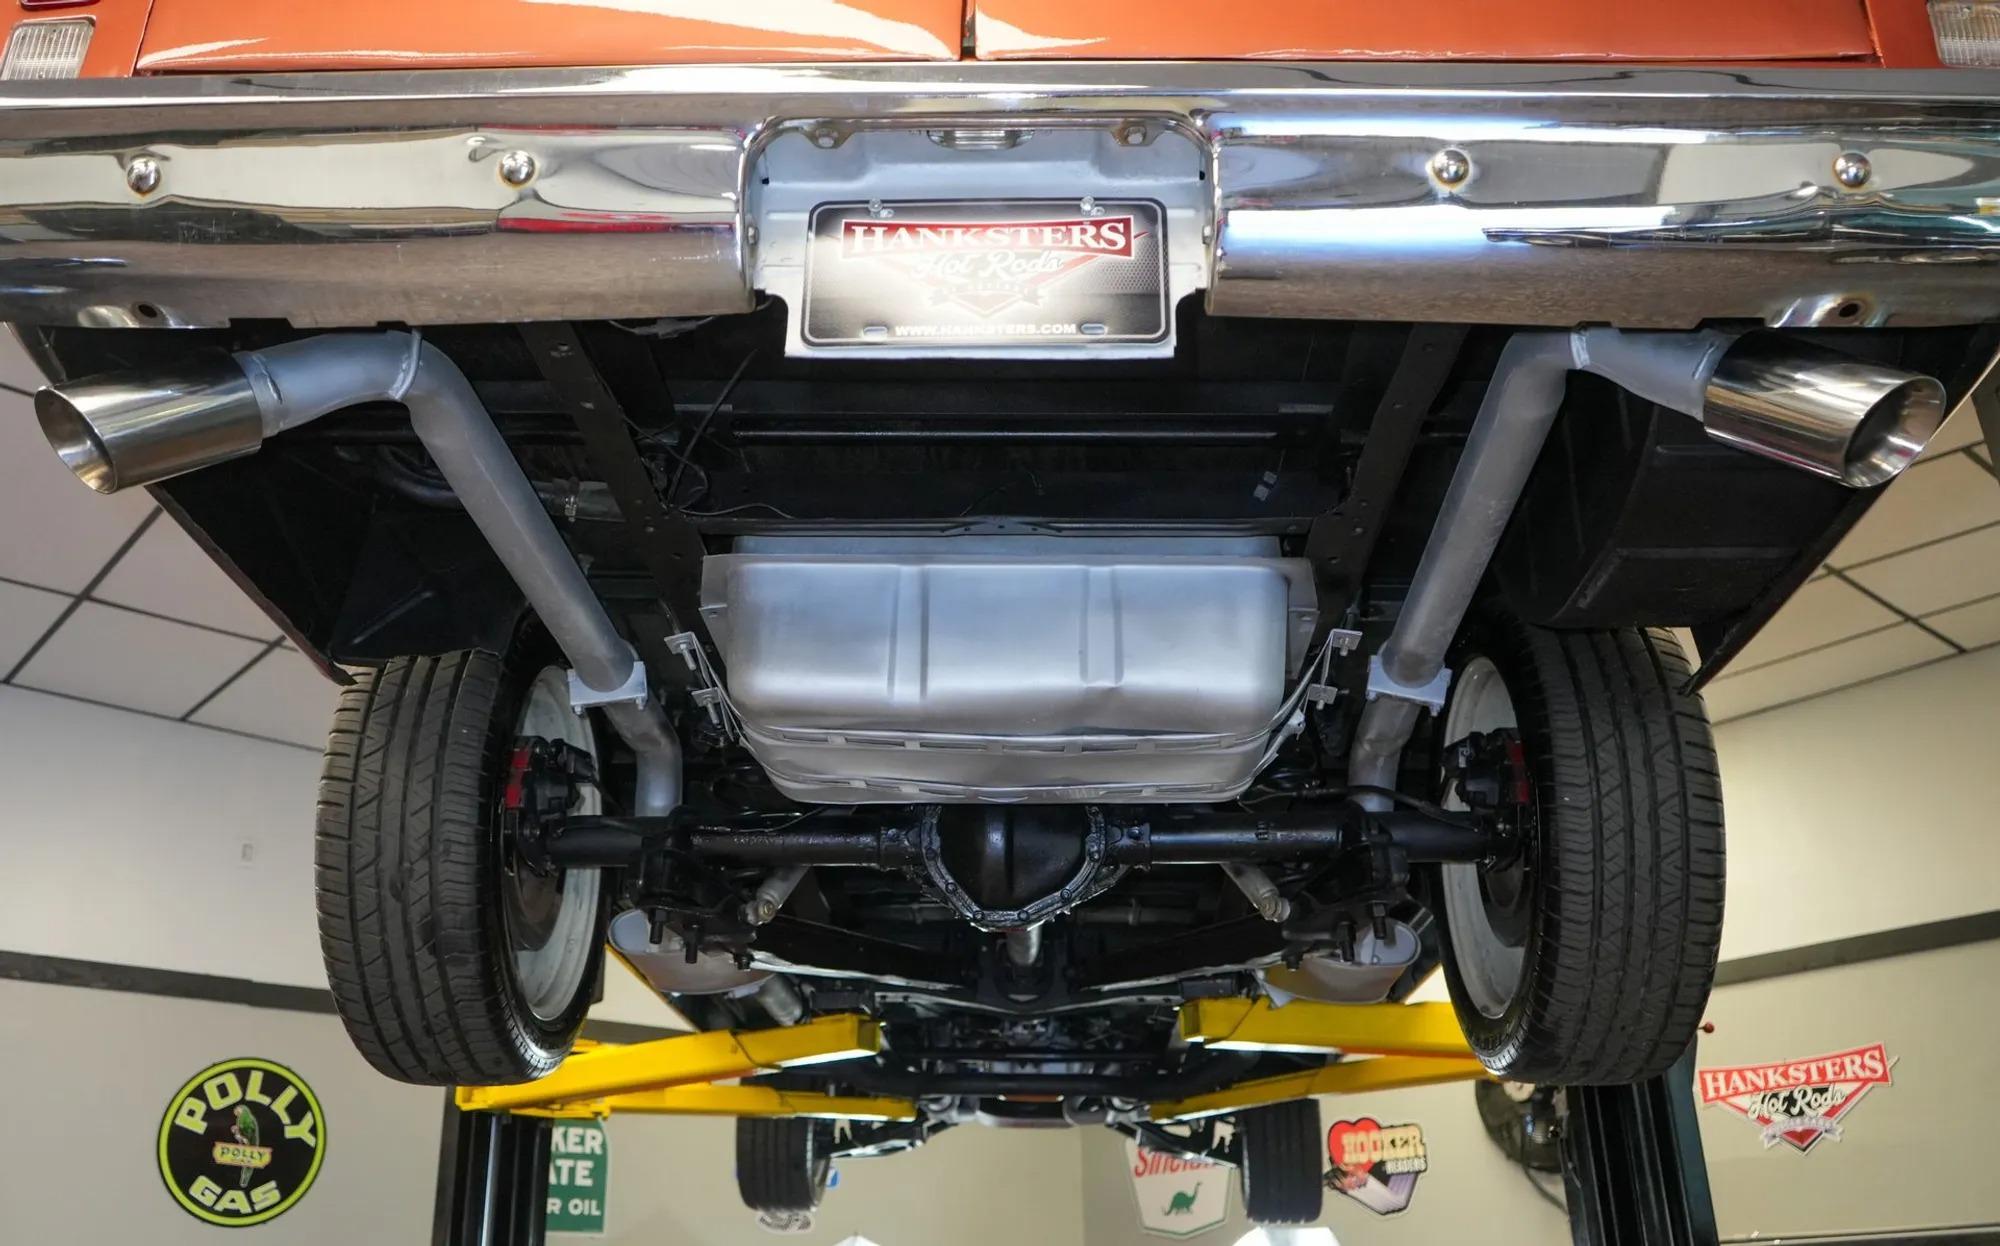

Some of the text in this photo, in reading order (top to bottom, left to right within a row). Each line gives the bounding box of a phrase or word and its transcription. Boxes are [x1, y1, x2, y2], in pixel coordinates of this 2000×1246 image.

[848, 221, 1127, 252] HANKSTERS
[912, 249, 1064, 281] Hot Rods
[894, 323, 1077, 337] WWW.HANKSTERS.COM
[1704, 1050, 1884, 1099] HANKSTERS
[174, 1070, 317, 1148] POLLY
[1748, 1084, 1846, 1119] Hot Rods
[221, 1146, 264, 1161] POLLY
[1342, 1125, 1425, 1165] HOOKER
[188, 1175, 281, 1214] GAS
[568, 1198, 601, 1216] OIL
